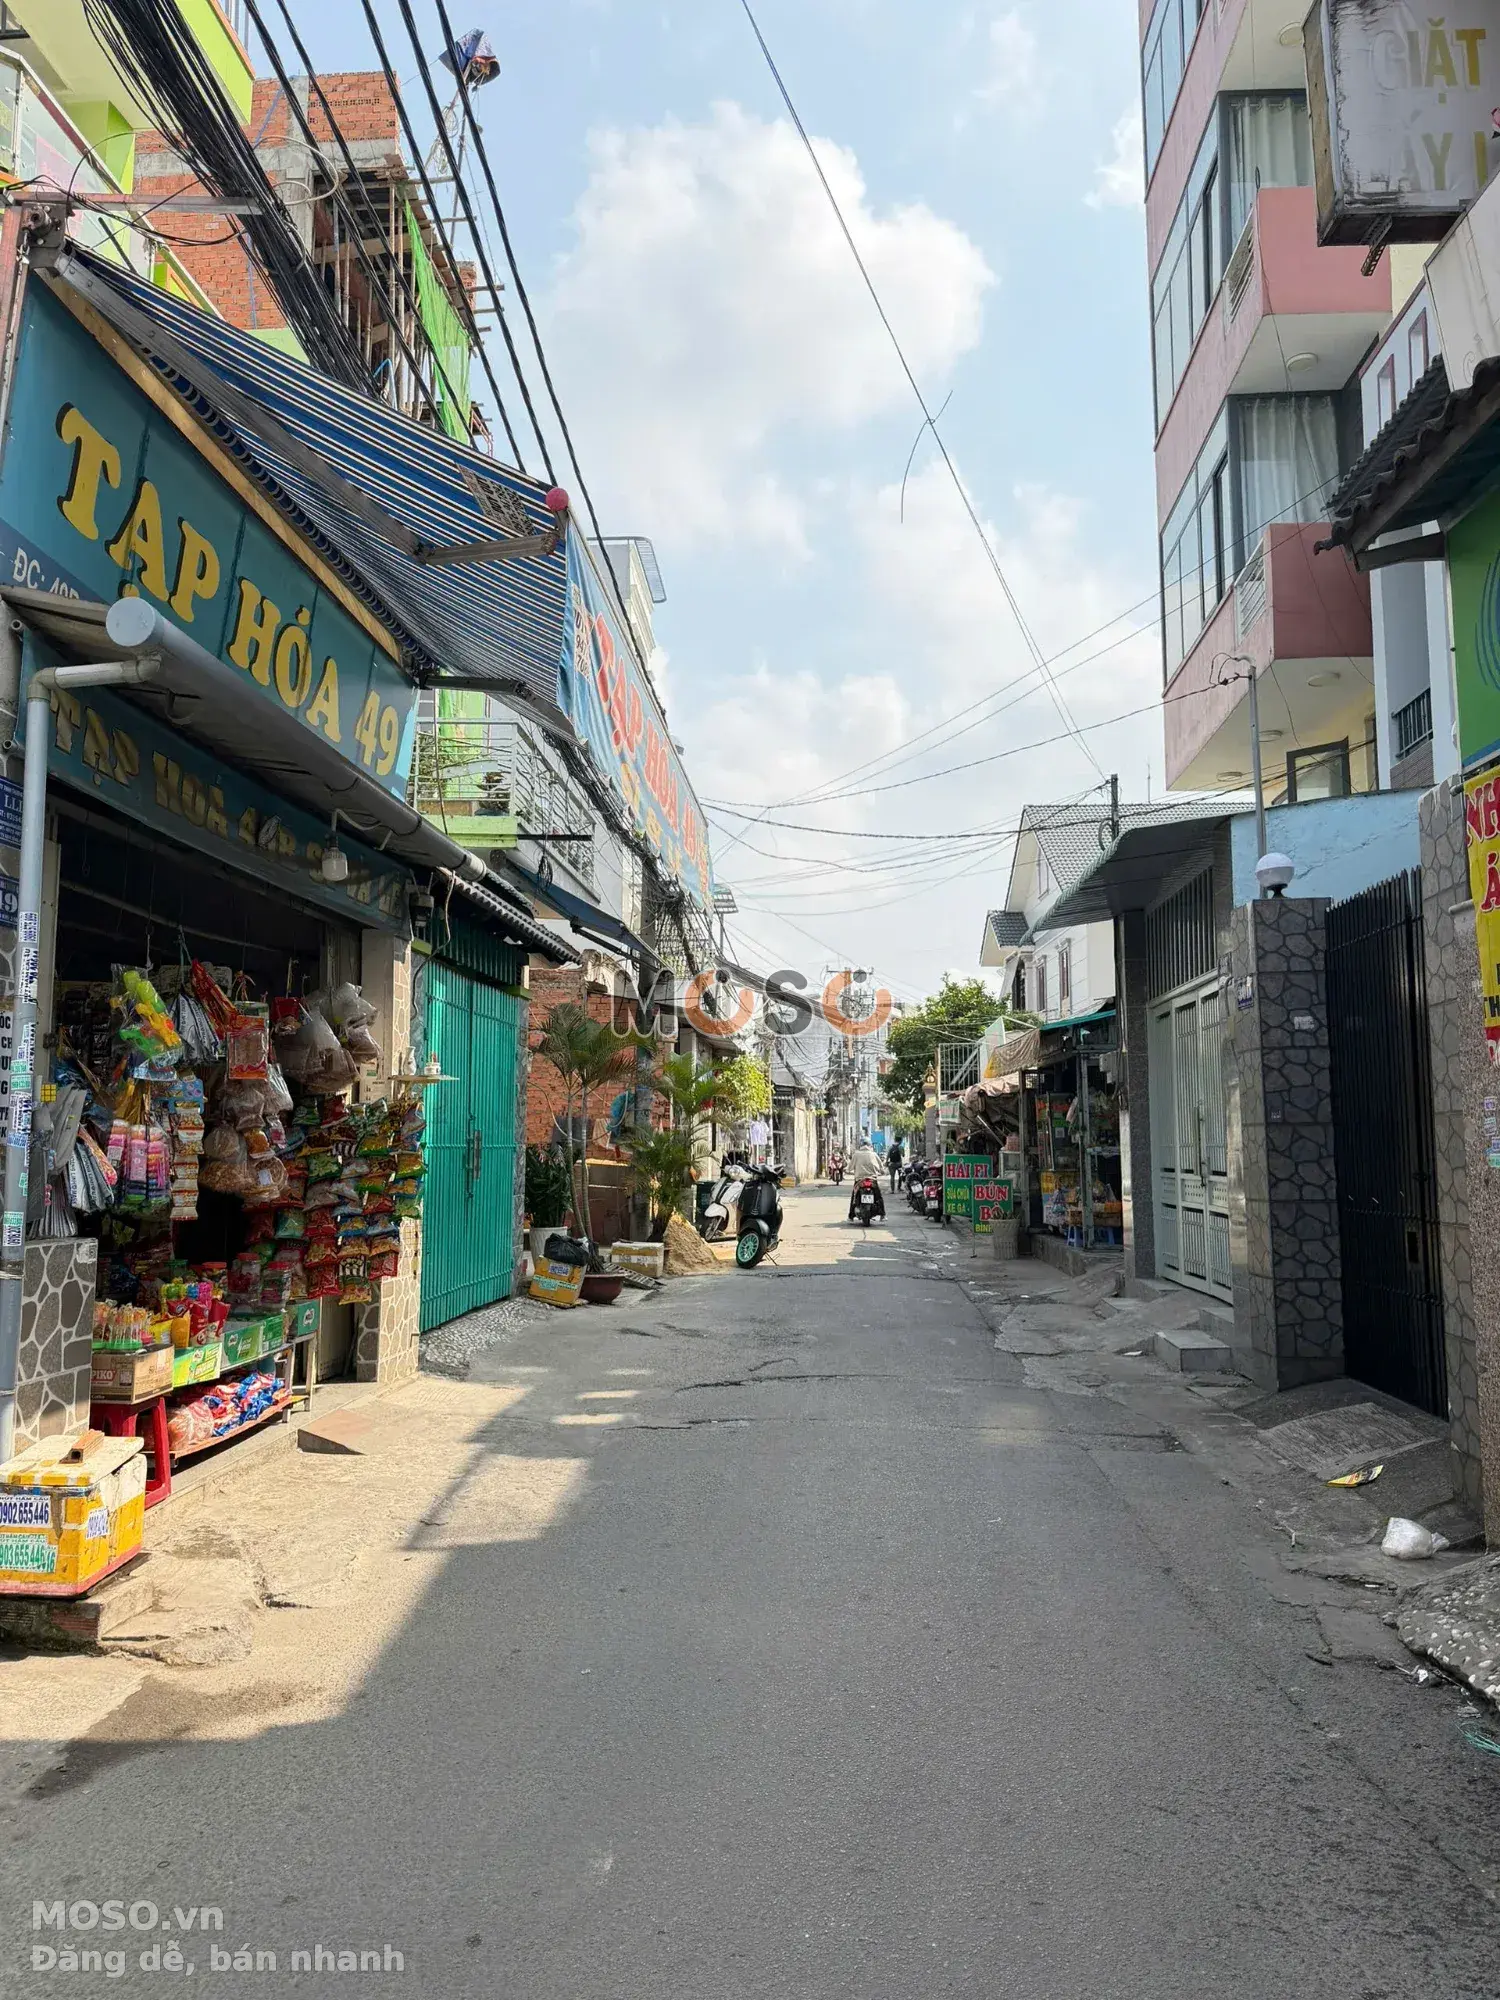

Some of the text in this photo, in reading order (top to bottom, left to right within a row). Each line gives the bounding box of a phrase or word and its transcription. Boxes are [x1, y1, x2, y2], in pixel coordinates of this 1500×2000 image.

[55, 402, 221, 623] TẠP
[354, 690, 399, 777] 49
[974, 1180, 1009, 1201] BÚN
